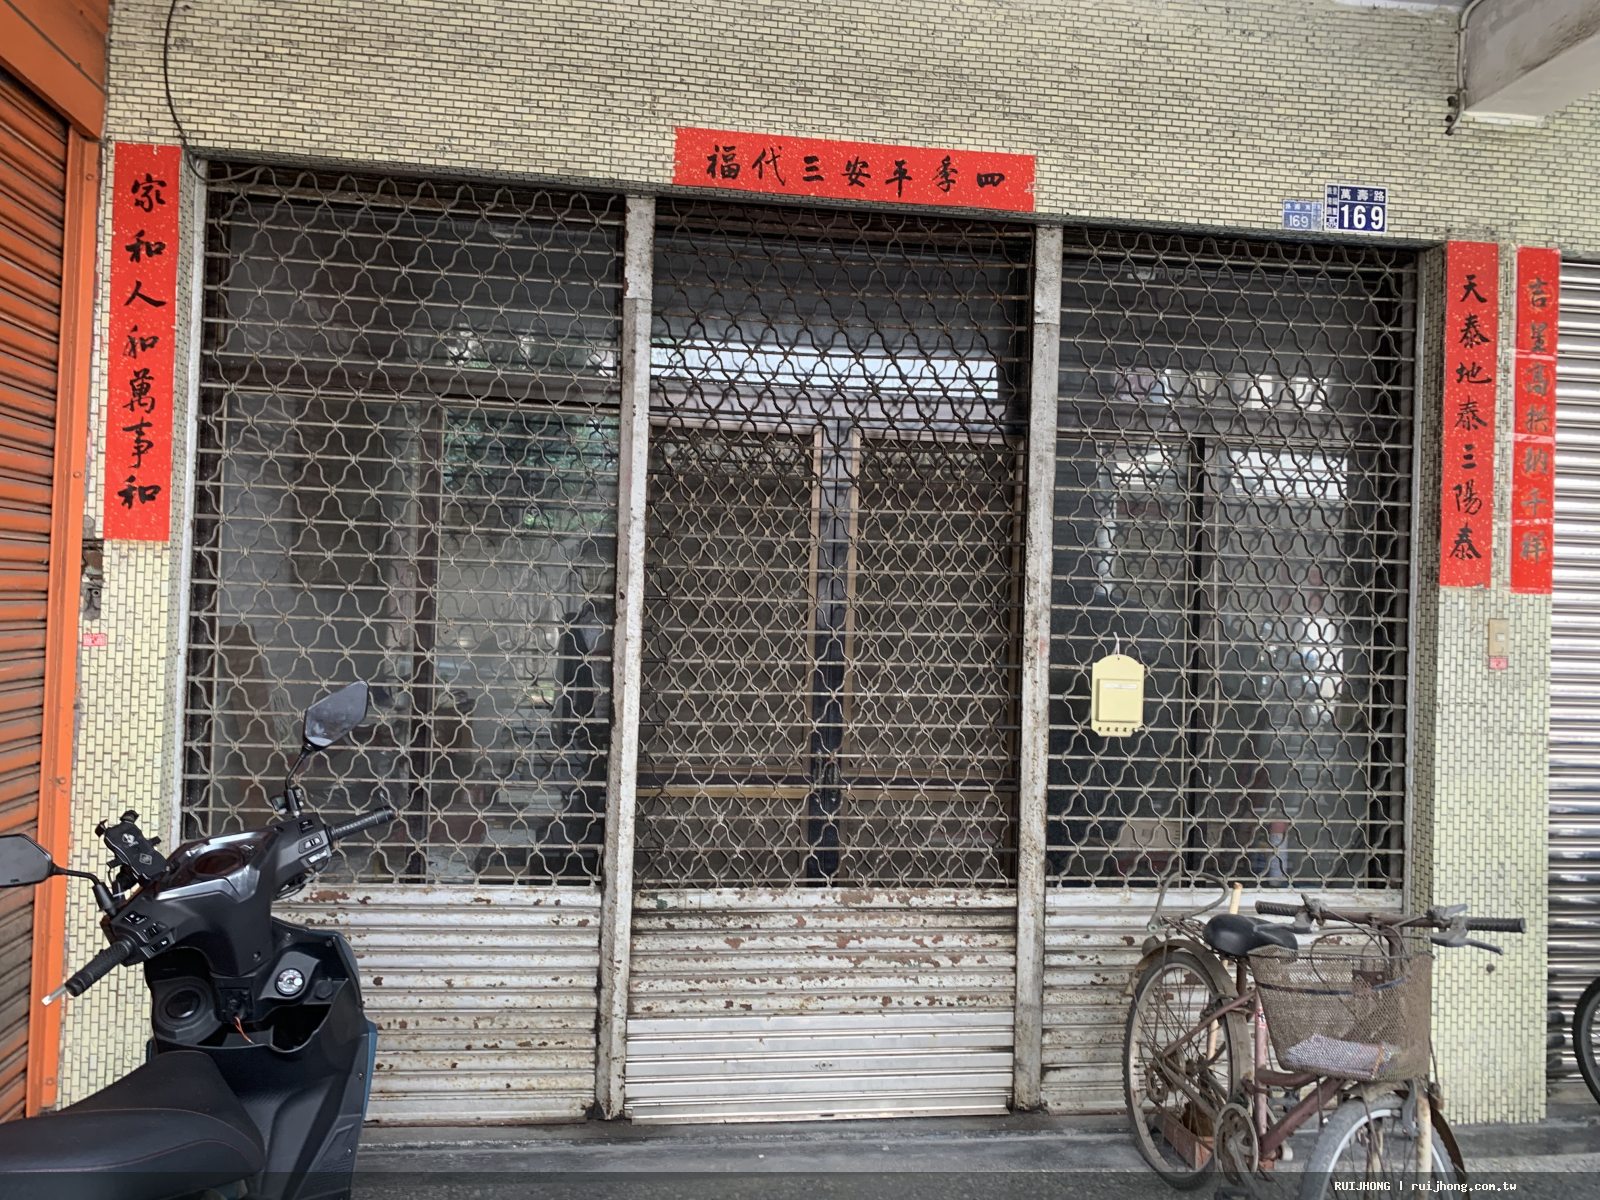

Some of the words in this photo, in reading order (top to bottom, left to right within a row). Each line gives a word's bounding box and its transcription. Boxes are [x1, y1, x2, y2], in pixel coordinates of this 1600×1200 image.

[1289, 214, 1309, 228] 169
[1341, 204, 1384, 230] 169
[117, 173, 168, 508] 家和人和萬事和
[1450, 274, 1492, 560] 天泰地泰三陽泰
